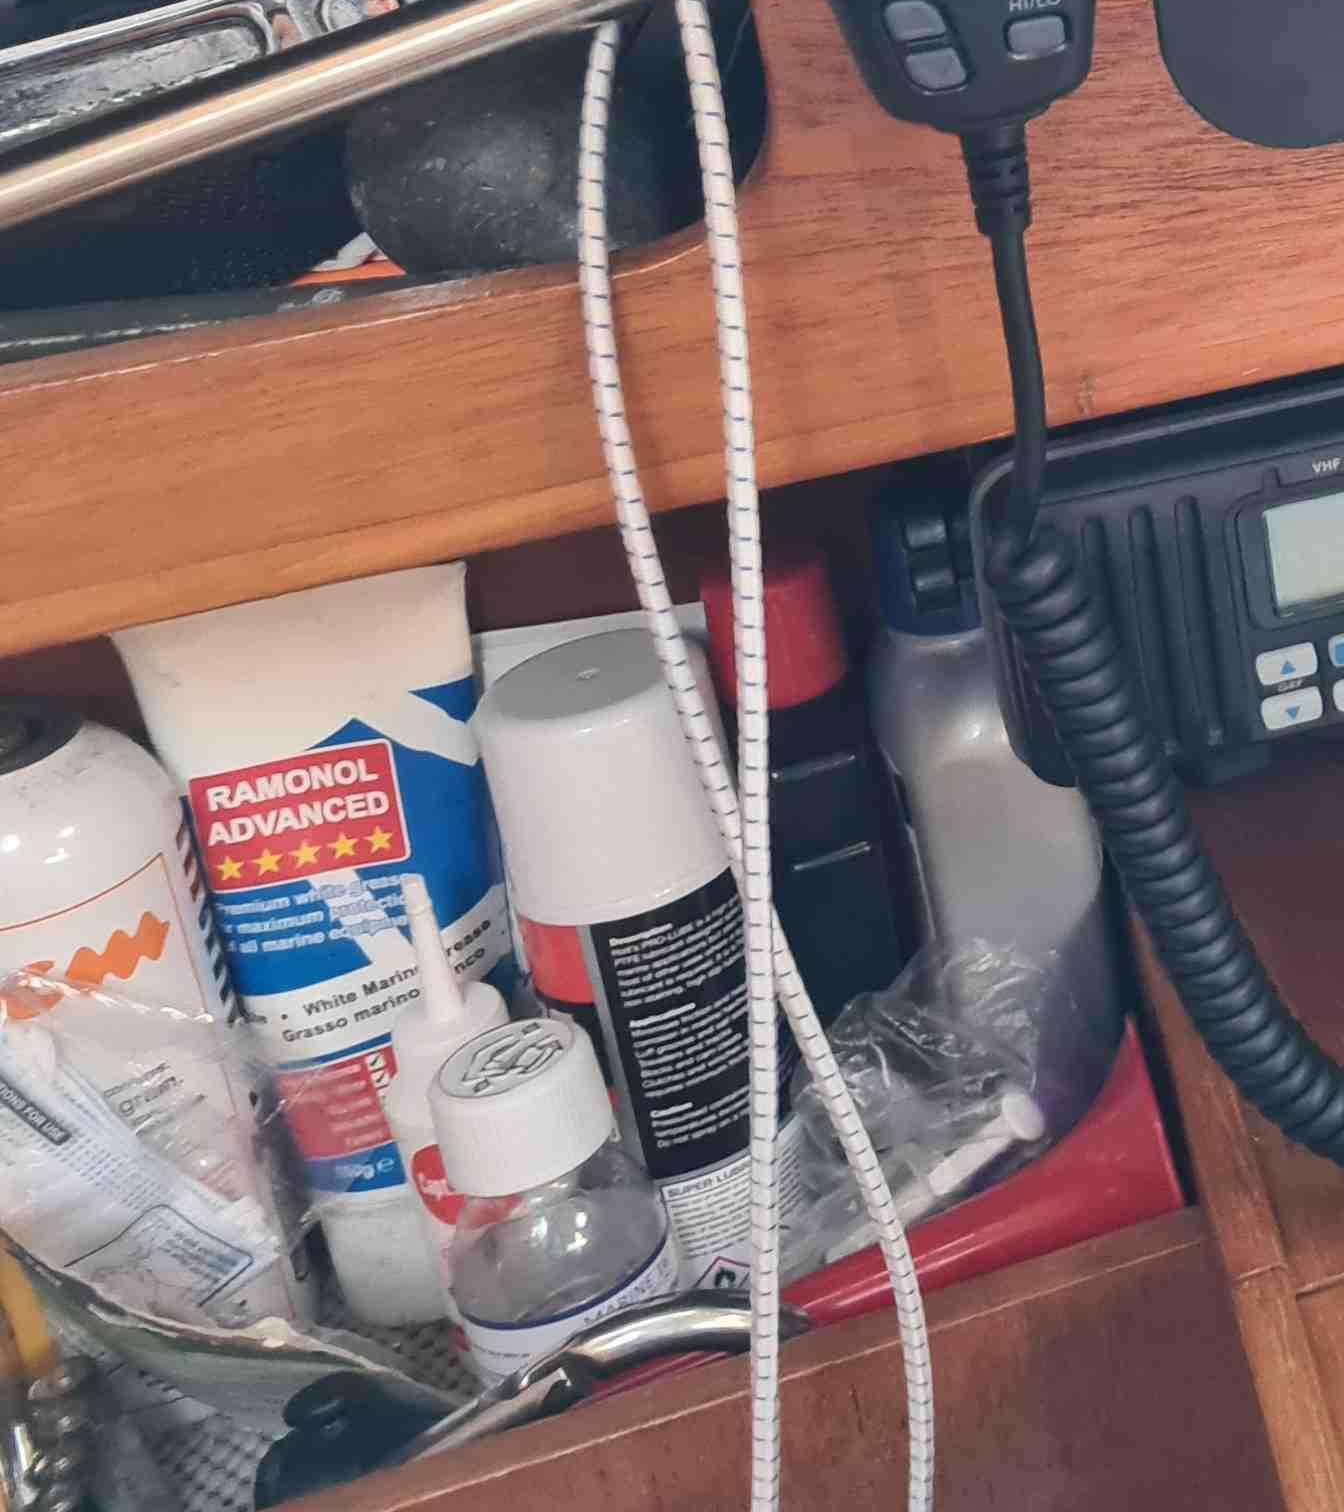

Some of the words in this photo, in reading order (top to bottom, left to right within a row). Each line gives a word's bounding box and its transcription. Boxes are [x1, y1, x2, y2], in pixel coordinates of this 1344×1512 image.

[1312, 453, 1342, 474] VHF
[206, 758, 379, 812] RAMONOL
[208, 791, 390, 846] ADVANCED
[282, 1017, 349, 1043] Grasso
[354, 988, 421, 1022] marino
[303, 991, 358, 1017] White
